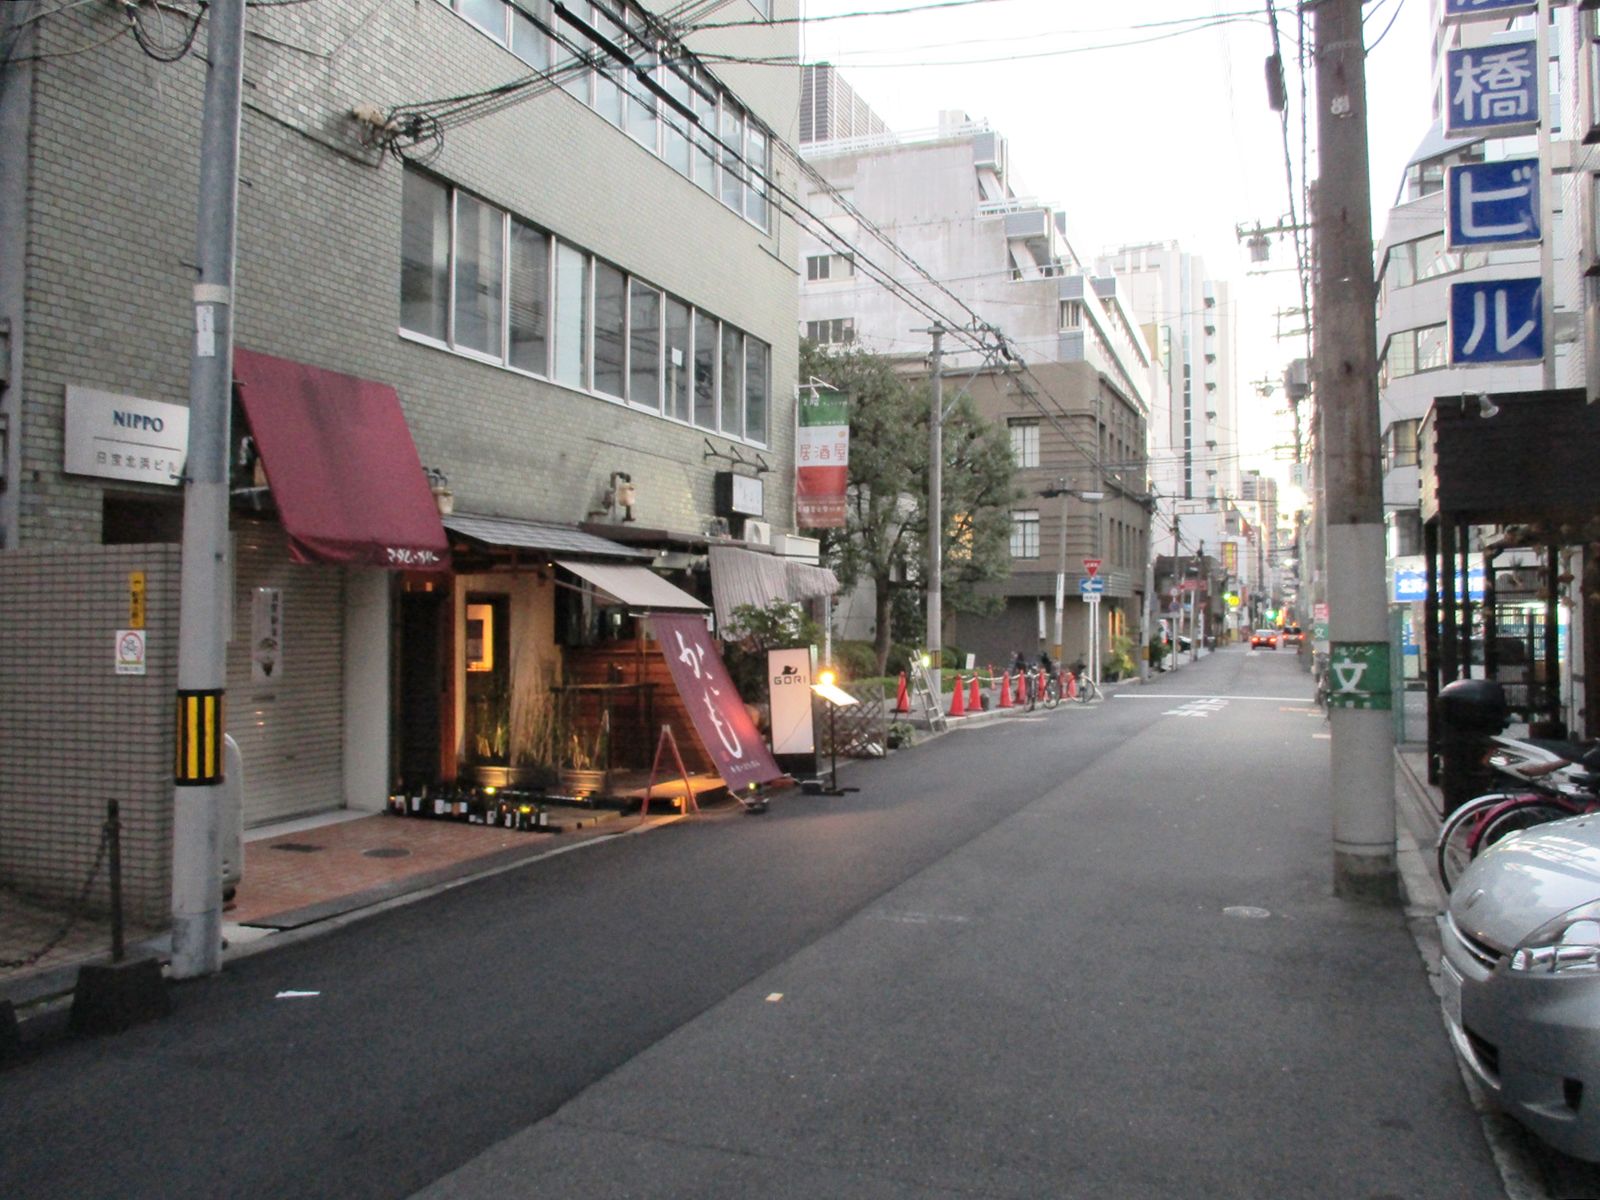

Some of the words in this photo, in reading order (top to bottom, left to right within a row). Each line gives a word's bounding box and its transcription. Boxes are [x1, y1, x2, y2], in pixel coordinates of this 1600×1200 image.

[113, 410, 164, 432] NIPPO
[800, 443, 846, 461] 居酒屋
[774, 676, 806, 685] GORI
